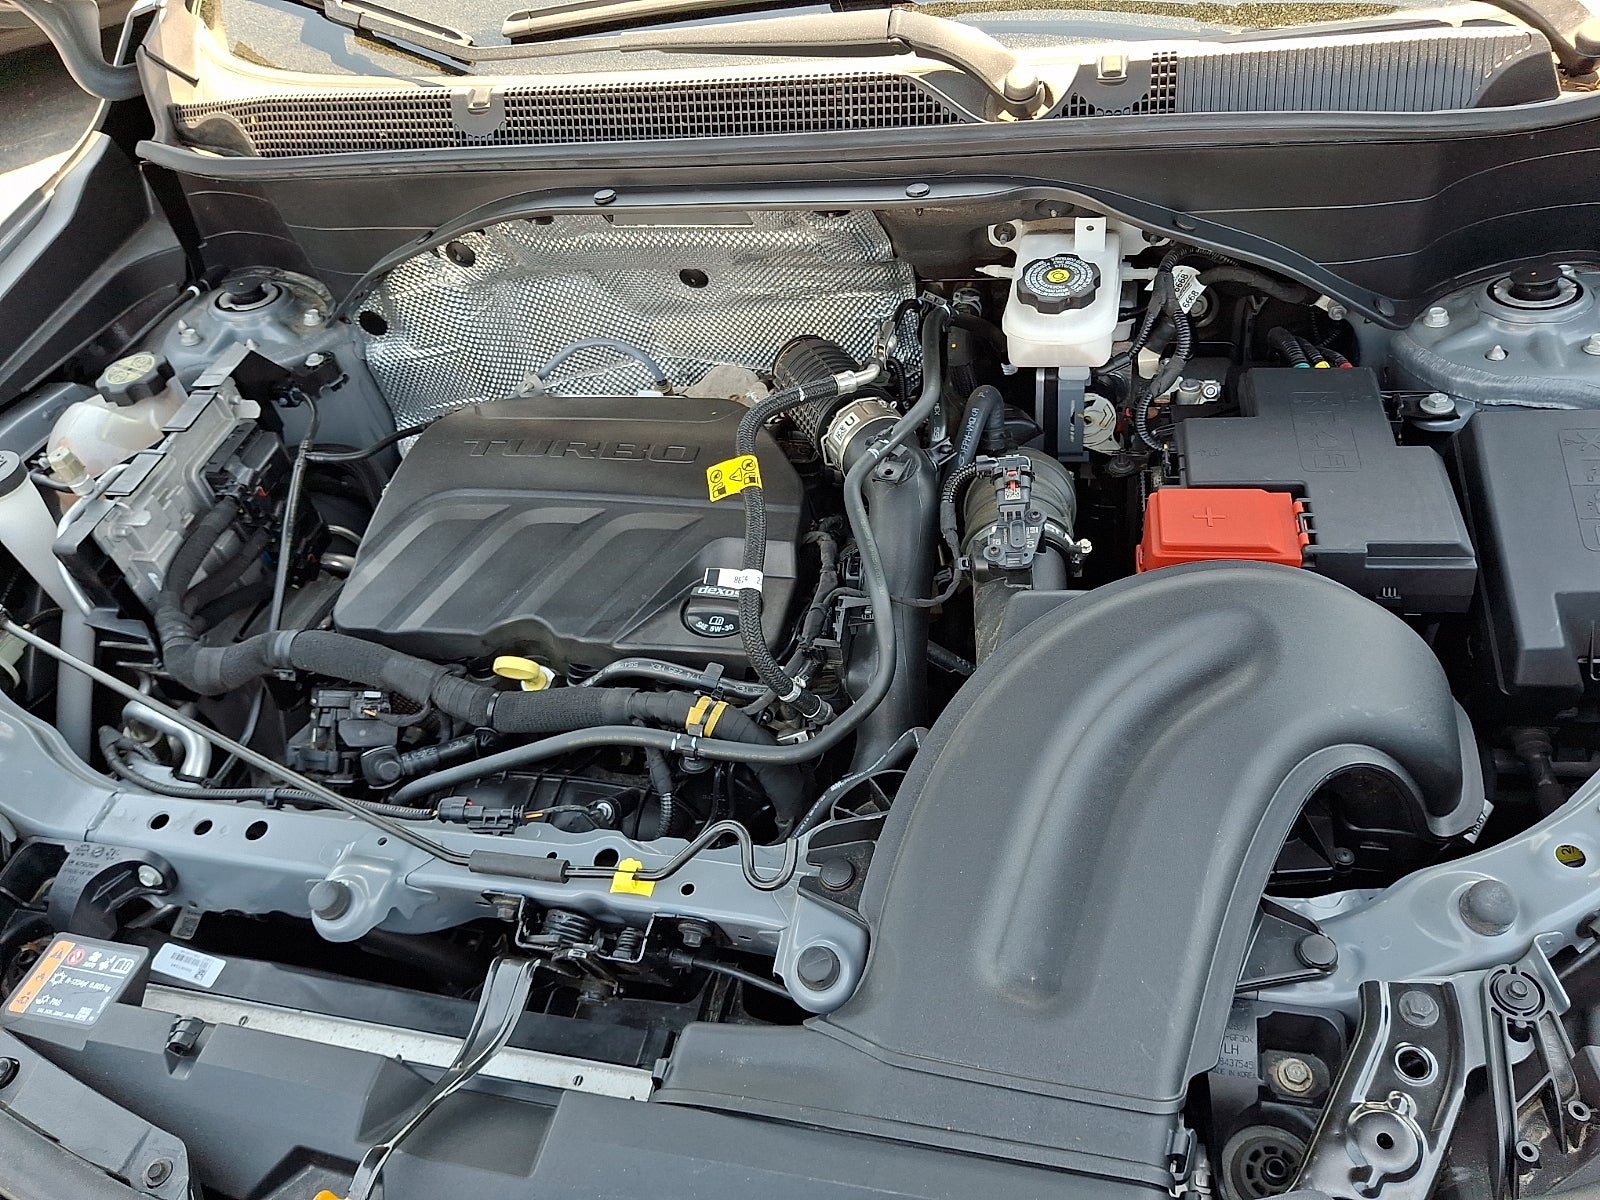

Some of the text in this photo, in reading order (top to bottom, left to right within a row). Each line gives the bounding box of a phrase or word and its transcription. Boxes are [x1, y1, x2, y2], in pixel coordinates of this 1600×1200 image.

[463, 438, 700, 464] TURBO
[695, 621, 734, 633] SAE 5W-30
[1224, 1042, 1239, 1055] LH
